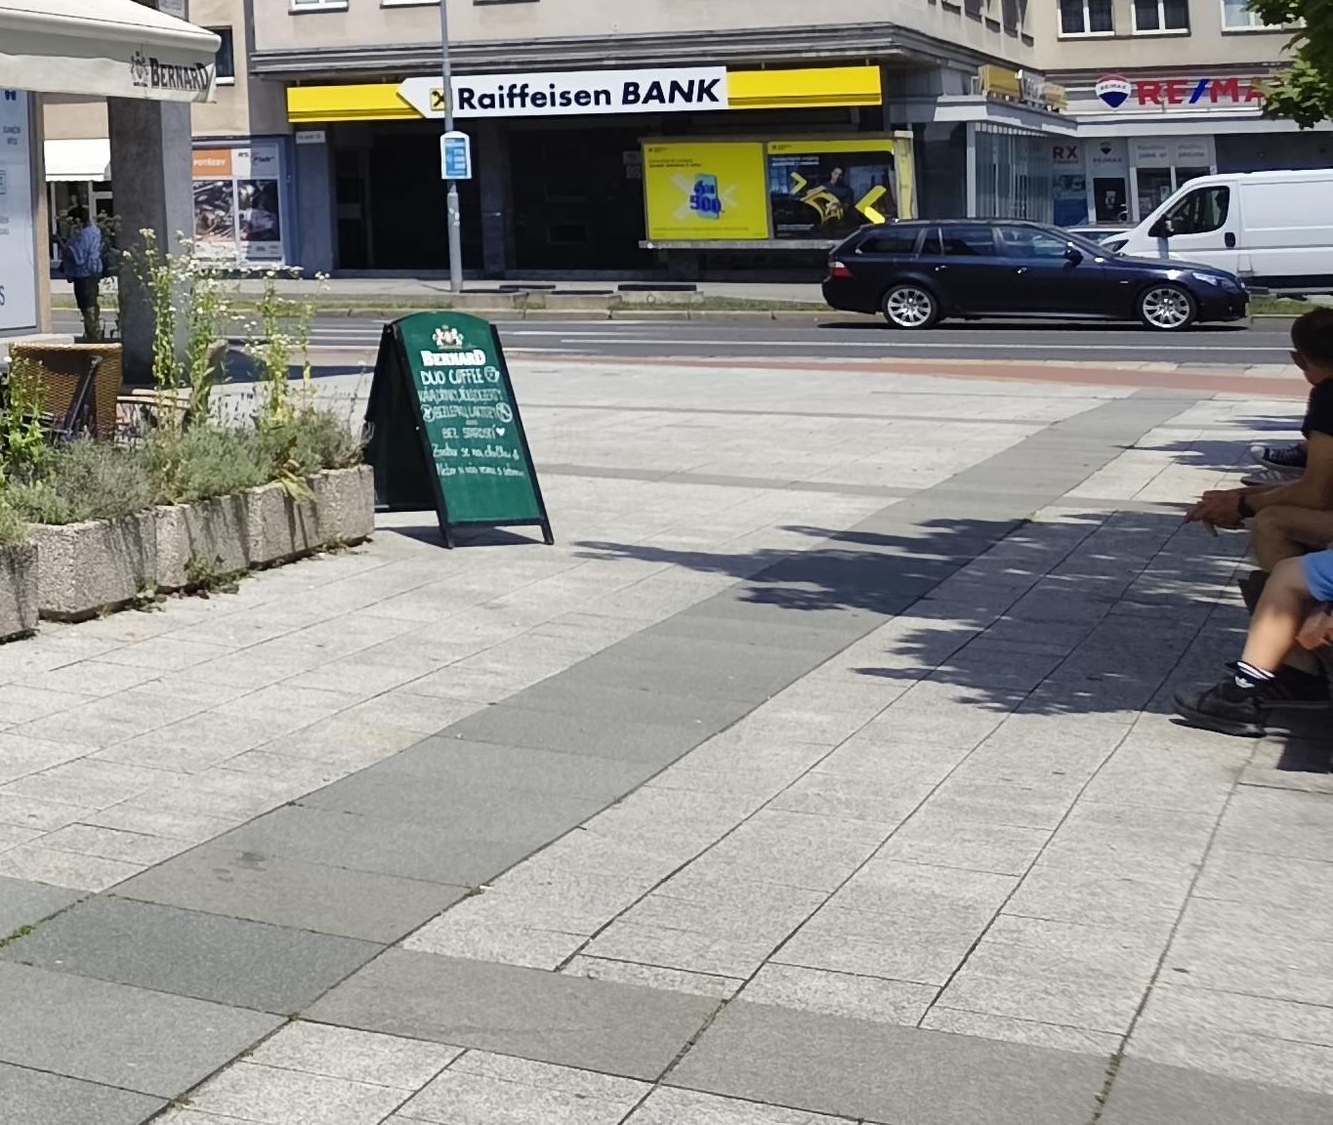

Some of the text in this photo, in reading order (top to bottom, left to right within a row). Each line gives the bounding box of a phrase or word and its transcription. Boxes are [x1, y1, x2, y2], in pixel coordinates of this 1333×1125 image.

[149, 57, 210, 92] BERNARD
[458, 78, 721, 111] Raiffeisen BANK
[1136, 77, 1278, 105] RE/MA
[421, 350, 486, 366] BERNARD
[421, 368, 485, 386] DUO COFFEE
